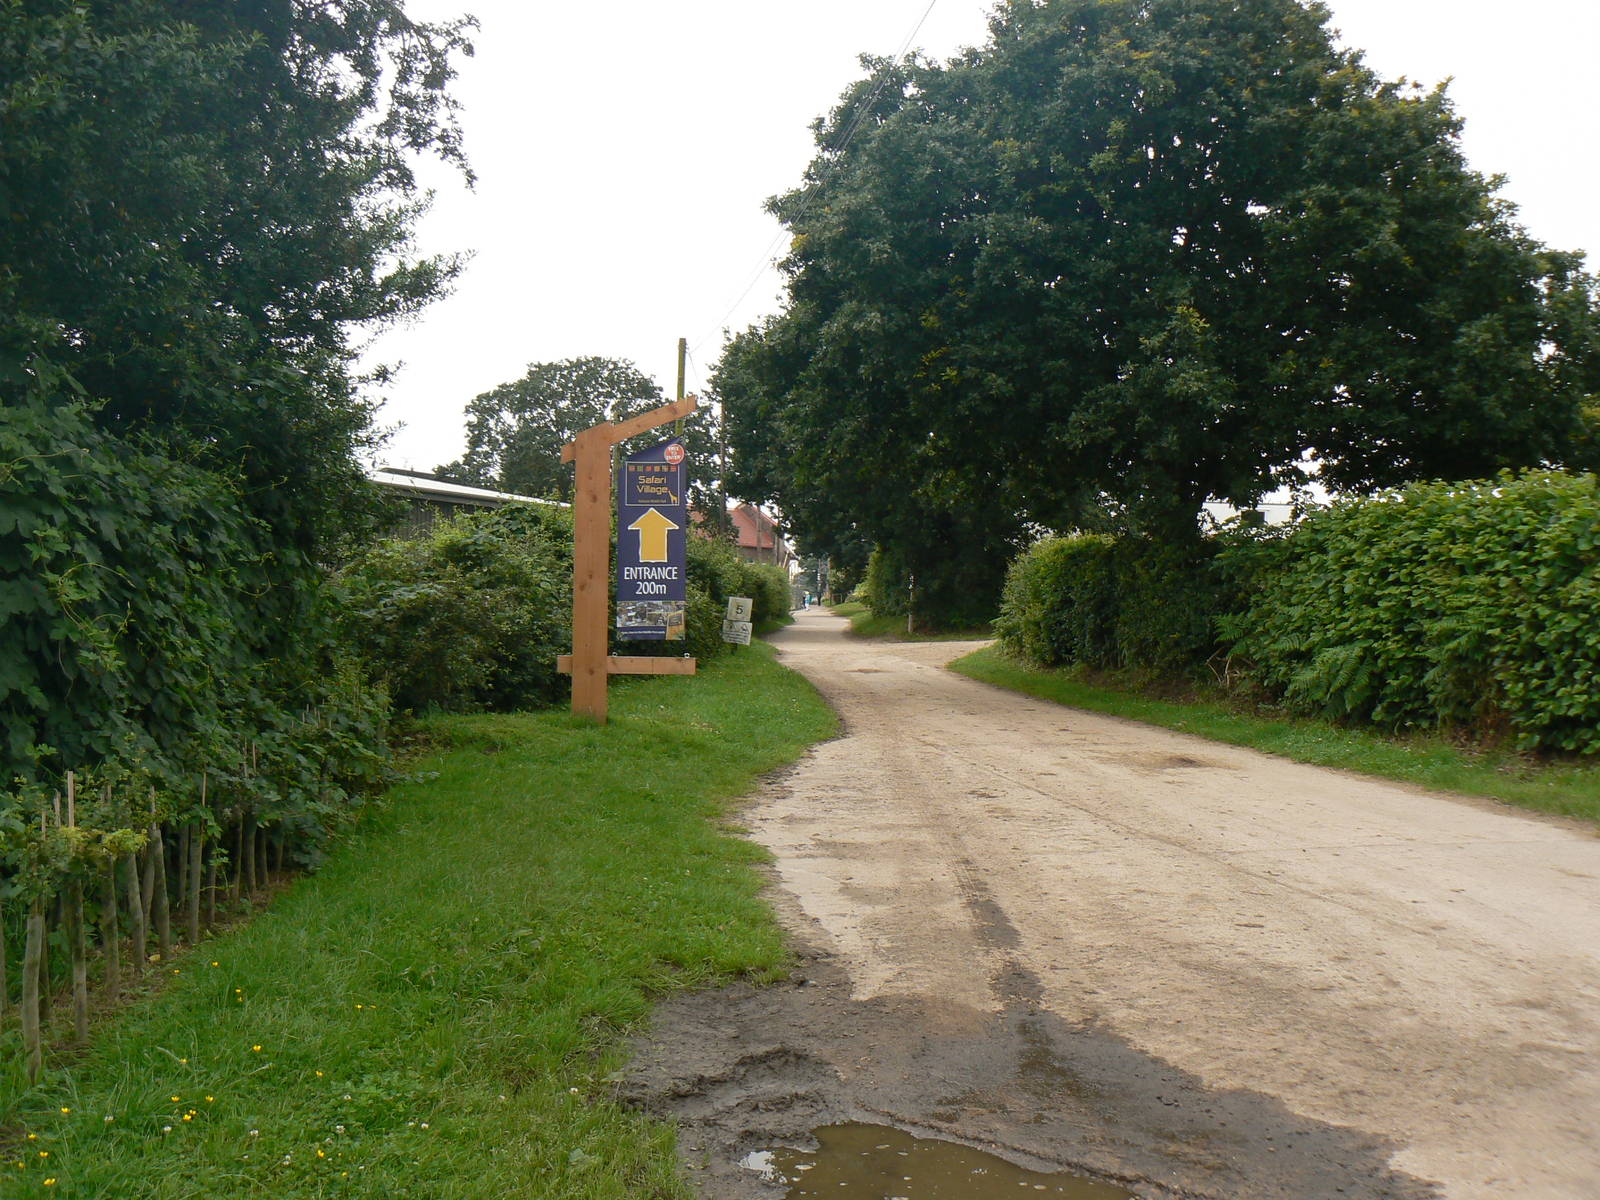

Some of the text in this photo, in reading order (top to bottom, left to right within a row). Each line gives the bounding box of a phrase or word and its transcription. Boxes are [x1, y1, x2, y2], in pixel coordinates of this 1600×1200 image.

[638, 475, 667, 484] Safari
[636, 485, 669, 495] Village
[624, 566, 678, 580] ENTRANCE
[635, 581, 667, 595] 200m
[736, 605, 744, 615] 5
